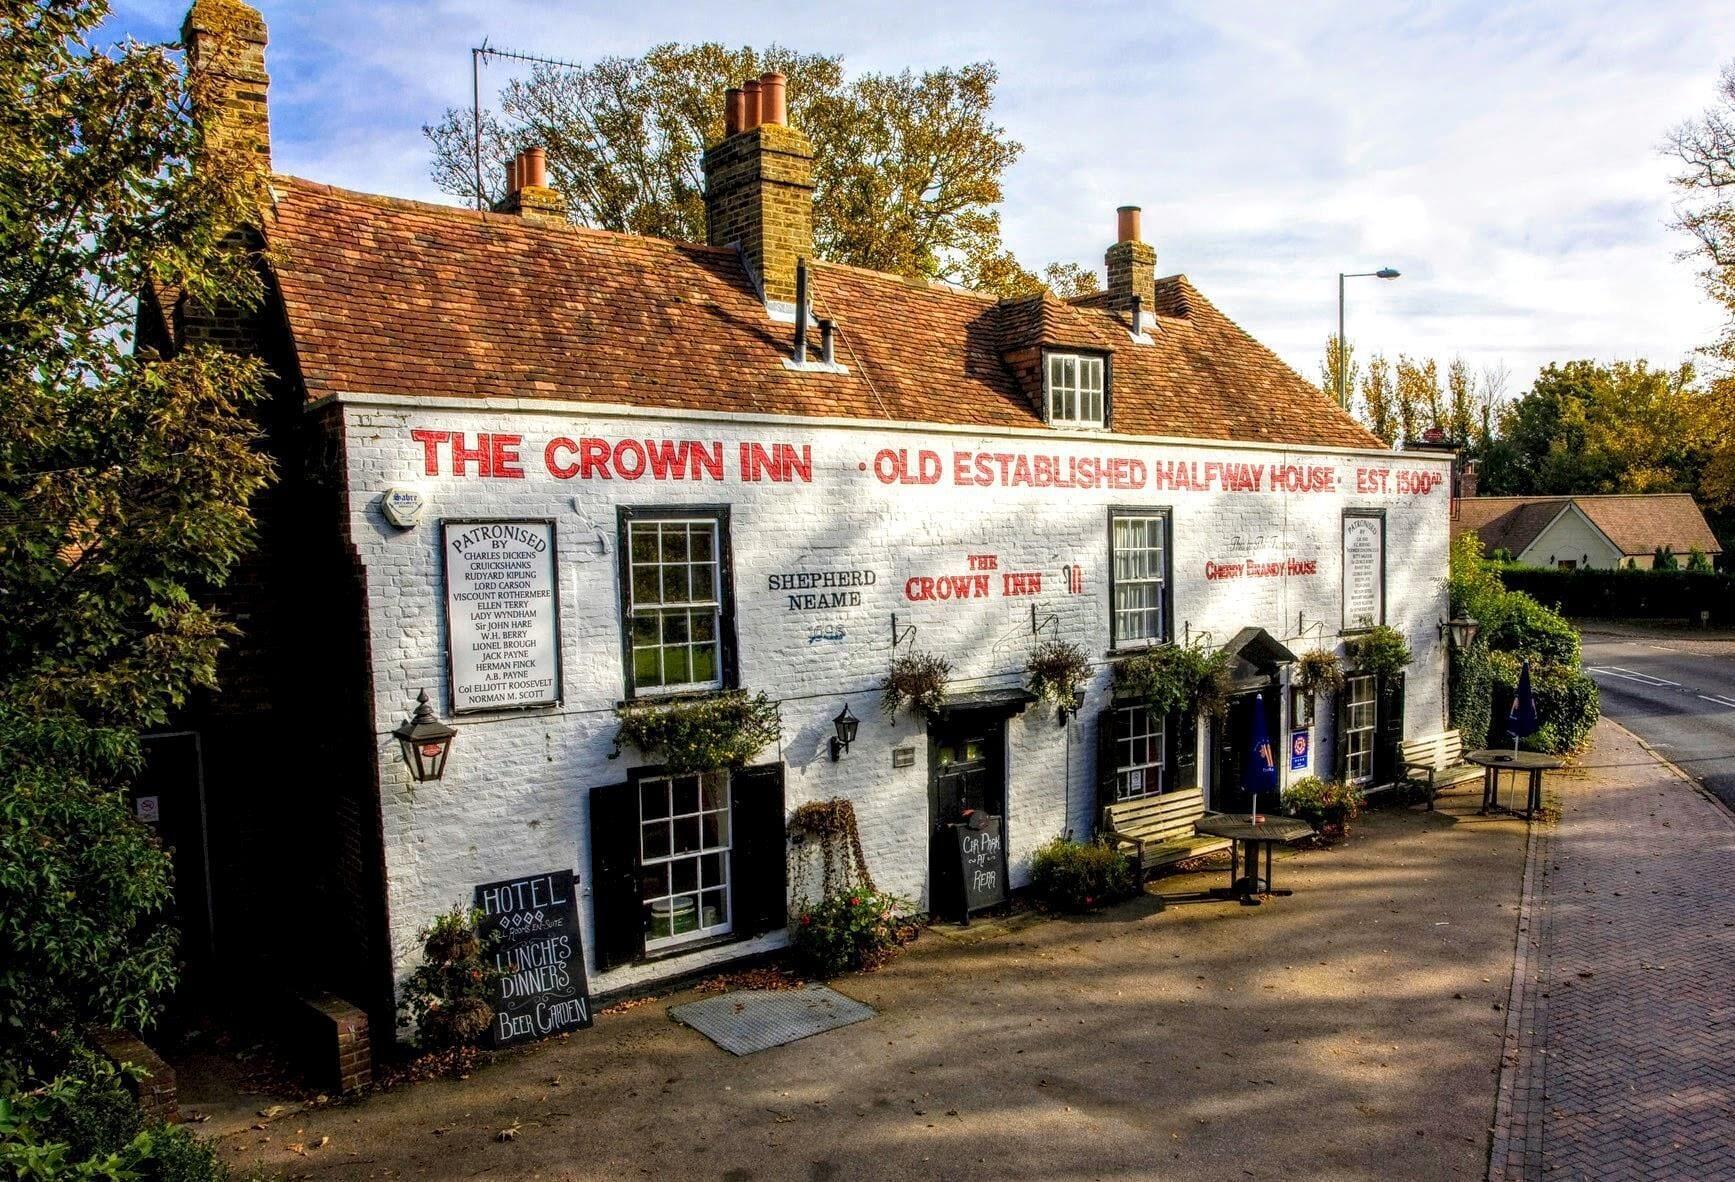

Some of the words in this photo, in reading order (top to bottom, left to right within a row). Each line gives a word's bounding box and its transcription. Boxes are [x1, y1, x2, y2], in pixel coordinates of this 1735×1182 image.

[411, 429, 525, 478] THE
[544, 438, 724, 481] CROWN
[740, 442, 812, 482] INN
[874, 449, 942, 484] OLD
[954, 451, 1147, 489] ESTABLISHED
[1156, 460, 1264, 492] HALFWAY
[1270, 464, 1336, 493] HOUSE
[1357, 468, 1391, 494] EST.
[393, 493, 417, 501] Sabre
[452, 525, 546, 553] PATRONISED
[492, 540, 508, 549] BY
[464, 552, 500, 560] CHARLES
[503, 551, 536, 559] DICKENS
[967, 554, 998, 570] THE
[471, 562, 531, 570] CRUICKSHANKS
[1205, 561, 1244, 580] CHERRY
[1246, 559, 1285, 577] BRANDY
[1287, 558, 1317, 575] HOUSE
[465, 572, 504, 581] RUDYARD
[507, 571, 537, 579] KIPLING
[768, 570, 876, 590] SHEPHERD
[475, 582, 496, 590] LORD
[499, 581, 530, 589] CARSON
[905, 575, 990, 601] CROWN
[1002, 573, 1042, 596] INN
[454, 592, 496, 601] VISCOUNT
[498, 590, 551, 600] ROTHERMERE
[788, 592, 861, 610] NEAME
[478, 602, 501, 610] ELLEN
[504, 601, 529, 609] TERRY
[471, 612, 492, 621] LADY
[494, 610, 537, 619] WYNDHAM
[475, 623, 486, 631] Sir
[488, 621, 509, 631] JOHN
[512, 620, 532, 628] HARE
[481, 632, 500, 640] W.H.
[503, 630, 527, 639] BERRY
[473, 642, 501, 651] LIONEL
[504, 640, 537, 649] BROUGH
[482, 652, 502, 662] JACK
[504, 650, 529, 659] PAYNE
[476, 662, 511, 671] HERMAN
[513, 660, 536, 668] FINCK
[485, 673, 501, 681] A.B.
[503, 671, 528, 680] PAYNE
[458, 685, 472, 694] Col
[474, 683, 507, 692] ELLIOTT
[509, 679, 552, 690] ROOSEVELT
[469, 694, 505, 704] NORMAN
[507, 692, 517, 700] M.
[520, 690, 545, 699] SCOTT
[981, 832, 1000, 854] PARK
[976, 853, 986, 867] AT
[973, 870, 996, 892] REAR
[483, 876, 566, 915] HOTEL
[508, 925, 530, 941] ROOMS
[496, 936, 571, 973] LUNCHES
[501, 962, 569, 998] DINNERS
[498, 1012, 537, 1040] BEER
[536, 997, 587, 1034] GARDEN
